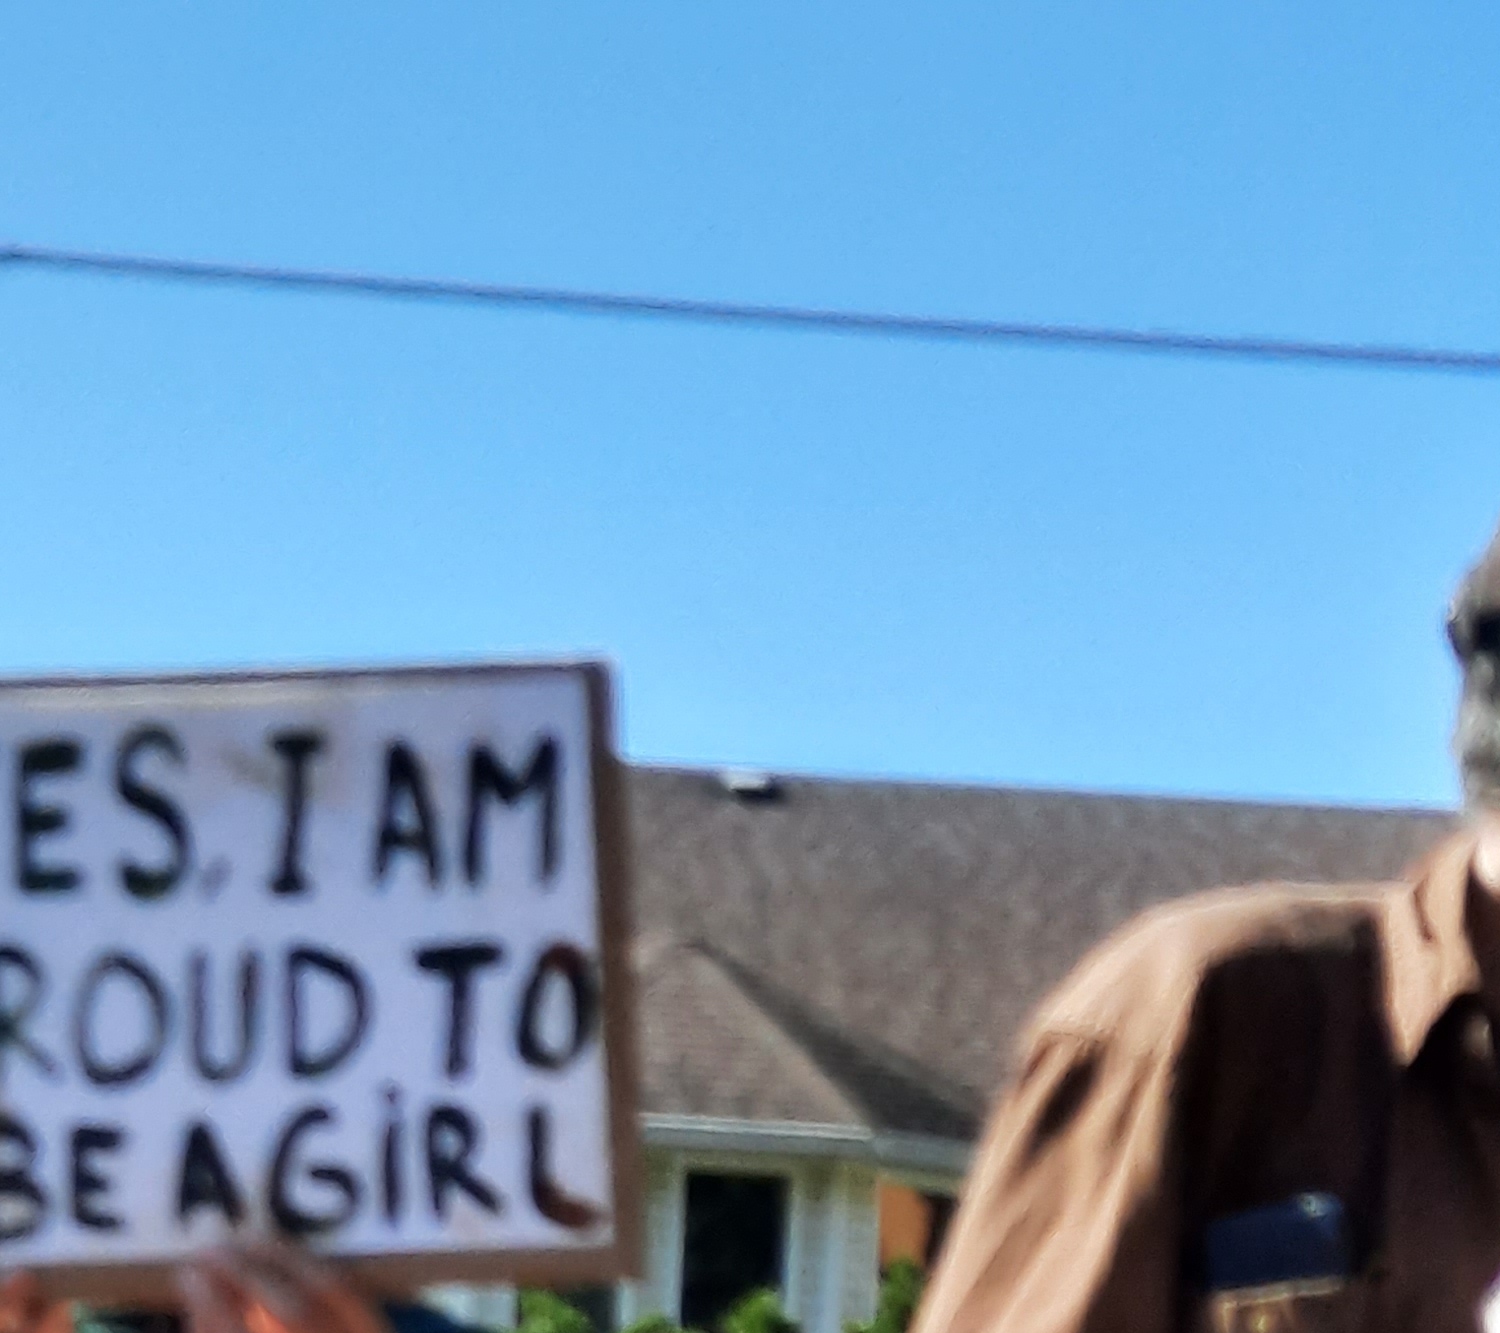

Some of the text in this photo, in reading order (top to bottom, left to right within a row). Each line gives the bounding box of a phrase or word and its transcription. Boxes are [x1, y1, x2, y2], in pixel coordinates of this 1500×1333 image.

[267, 726, 330, 897] I
[372, 734, 563, 887] AM
[412, 940, 596, 1078] TO
[173, 1120, 245, 1232] A
